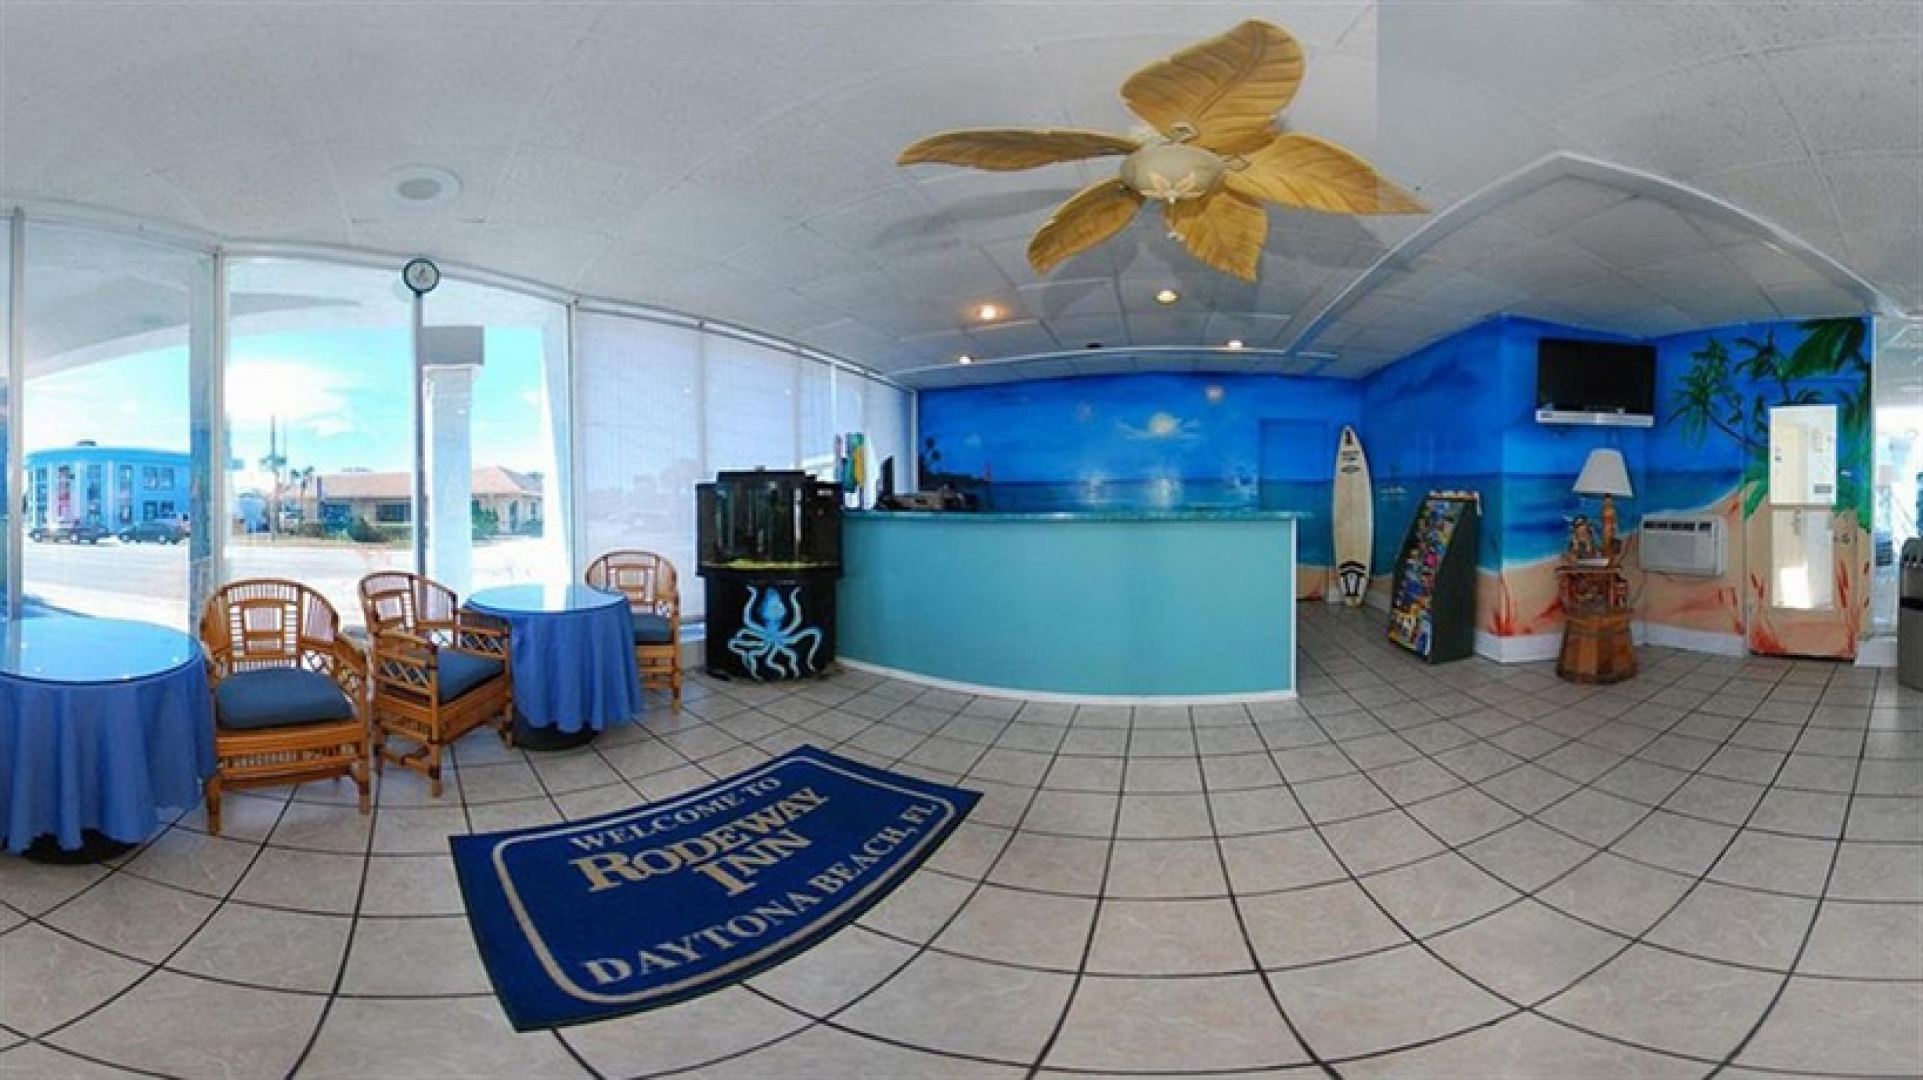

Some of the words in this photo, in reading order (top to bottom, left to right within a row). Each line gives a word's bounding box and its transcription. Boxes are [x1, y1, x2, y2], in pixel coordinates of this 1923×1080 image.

[569, 792, 745, 852] WELCOME
[739, 777, 782, 797] TO
[569, 786, 829, 892] RODEWAY
[583, 890, 816, 985] DAYTONA
[808, 820, 916, 892] BEACH,
[906, 803, 939, 835] FL
[694, 829, 814, 897] INN
